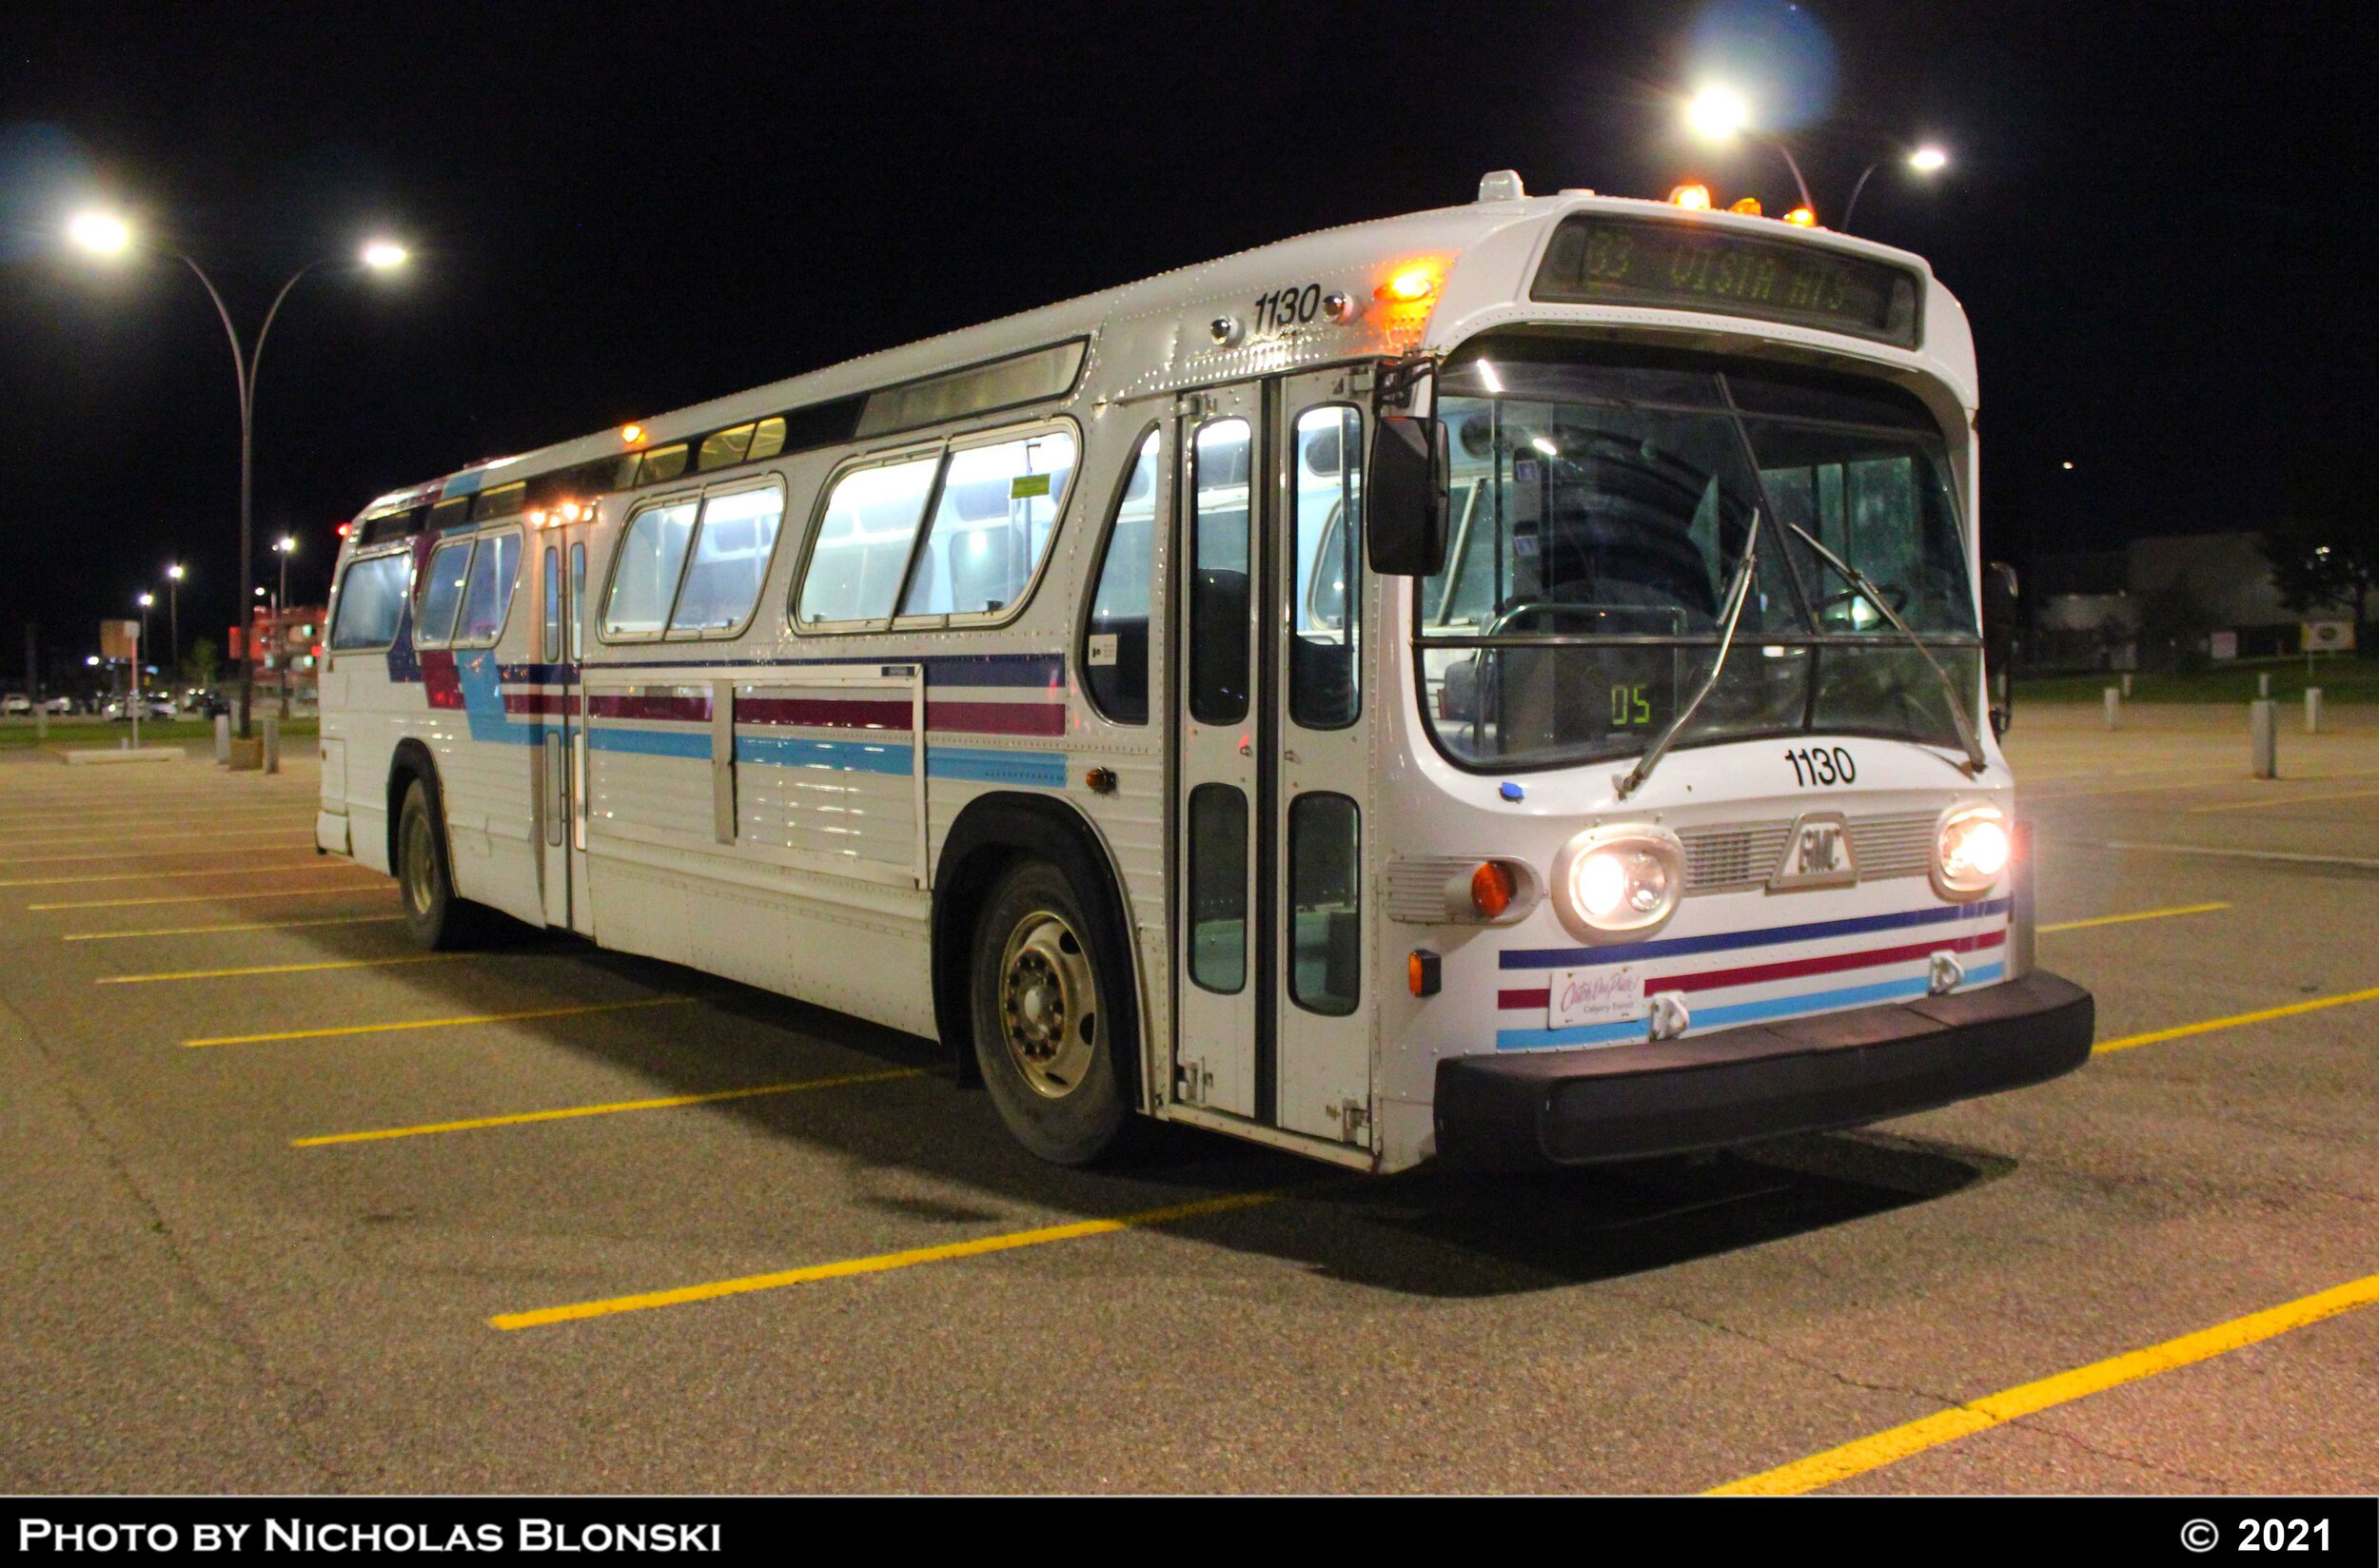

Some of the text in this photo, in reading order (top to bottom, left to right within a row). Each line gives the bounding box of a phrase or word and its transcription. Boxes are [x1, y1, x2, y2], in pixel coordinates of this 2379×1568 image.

[1255, 284, 1321, 334] 1130
[1784, 747, 1856, 787] 1130
[1583, 1001, 1635, 1015] Calgary Transit
